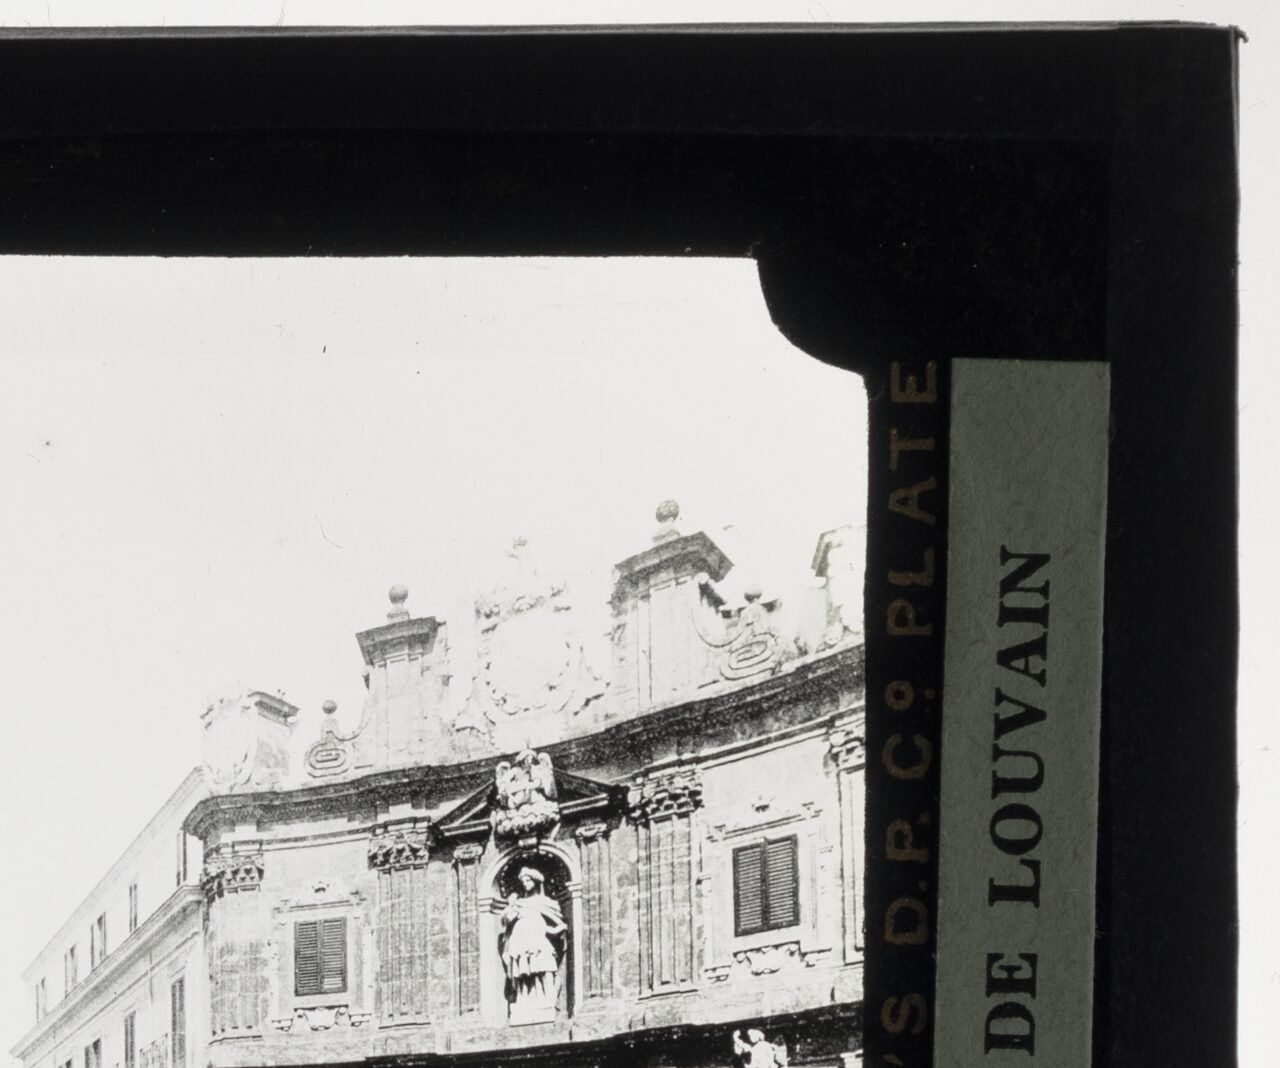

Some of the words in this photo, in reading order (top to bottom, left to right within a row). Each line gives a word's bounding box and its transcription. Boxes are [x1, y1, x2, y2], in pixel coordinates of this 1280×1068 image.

[886, 361, 937, 637] PLATE
[988, 544, 1051, 908] LOUVAIN
[984, 952, 1038, 1056] DE
